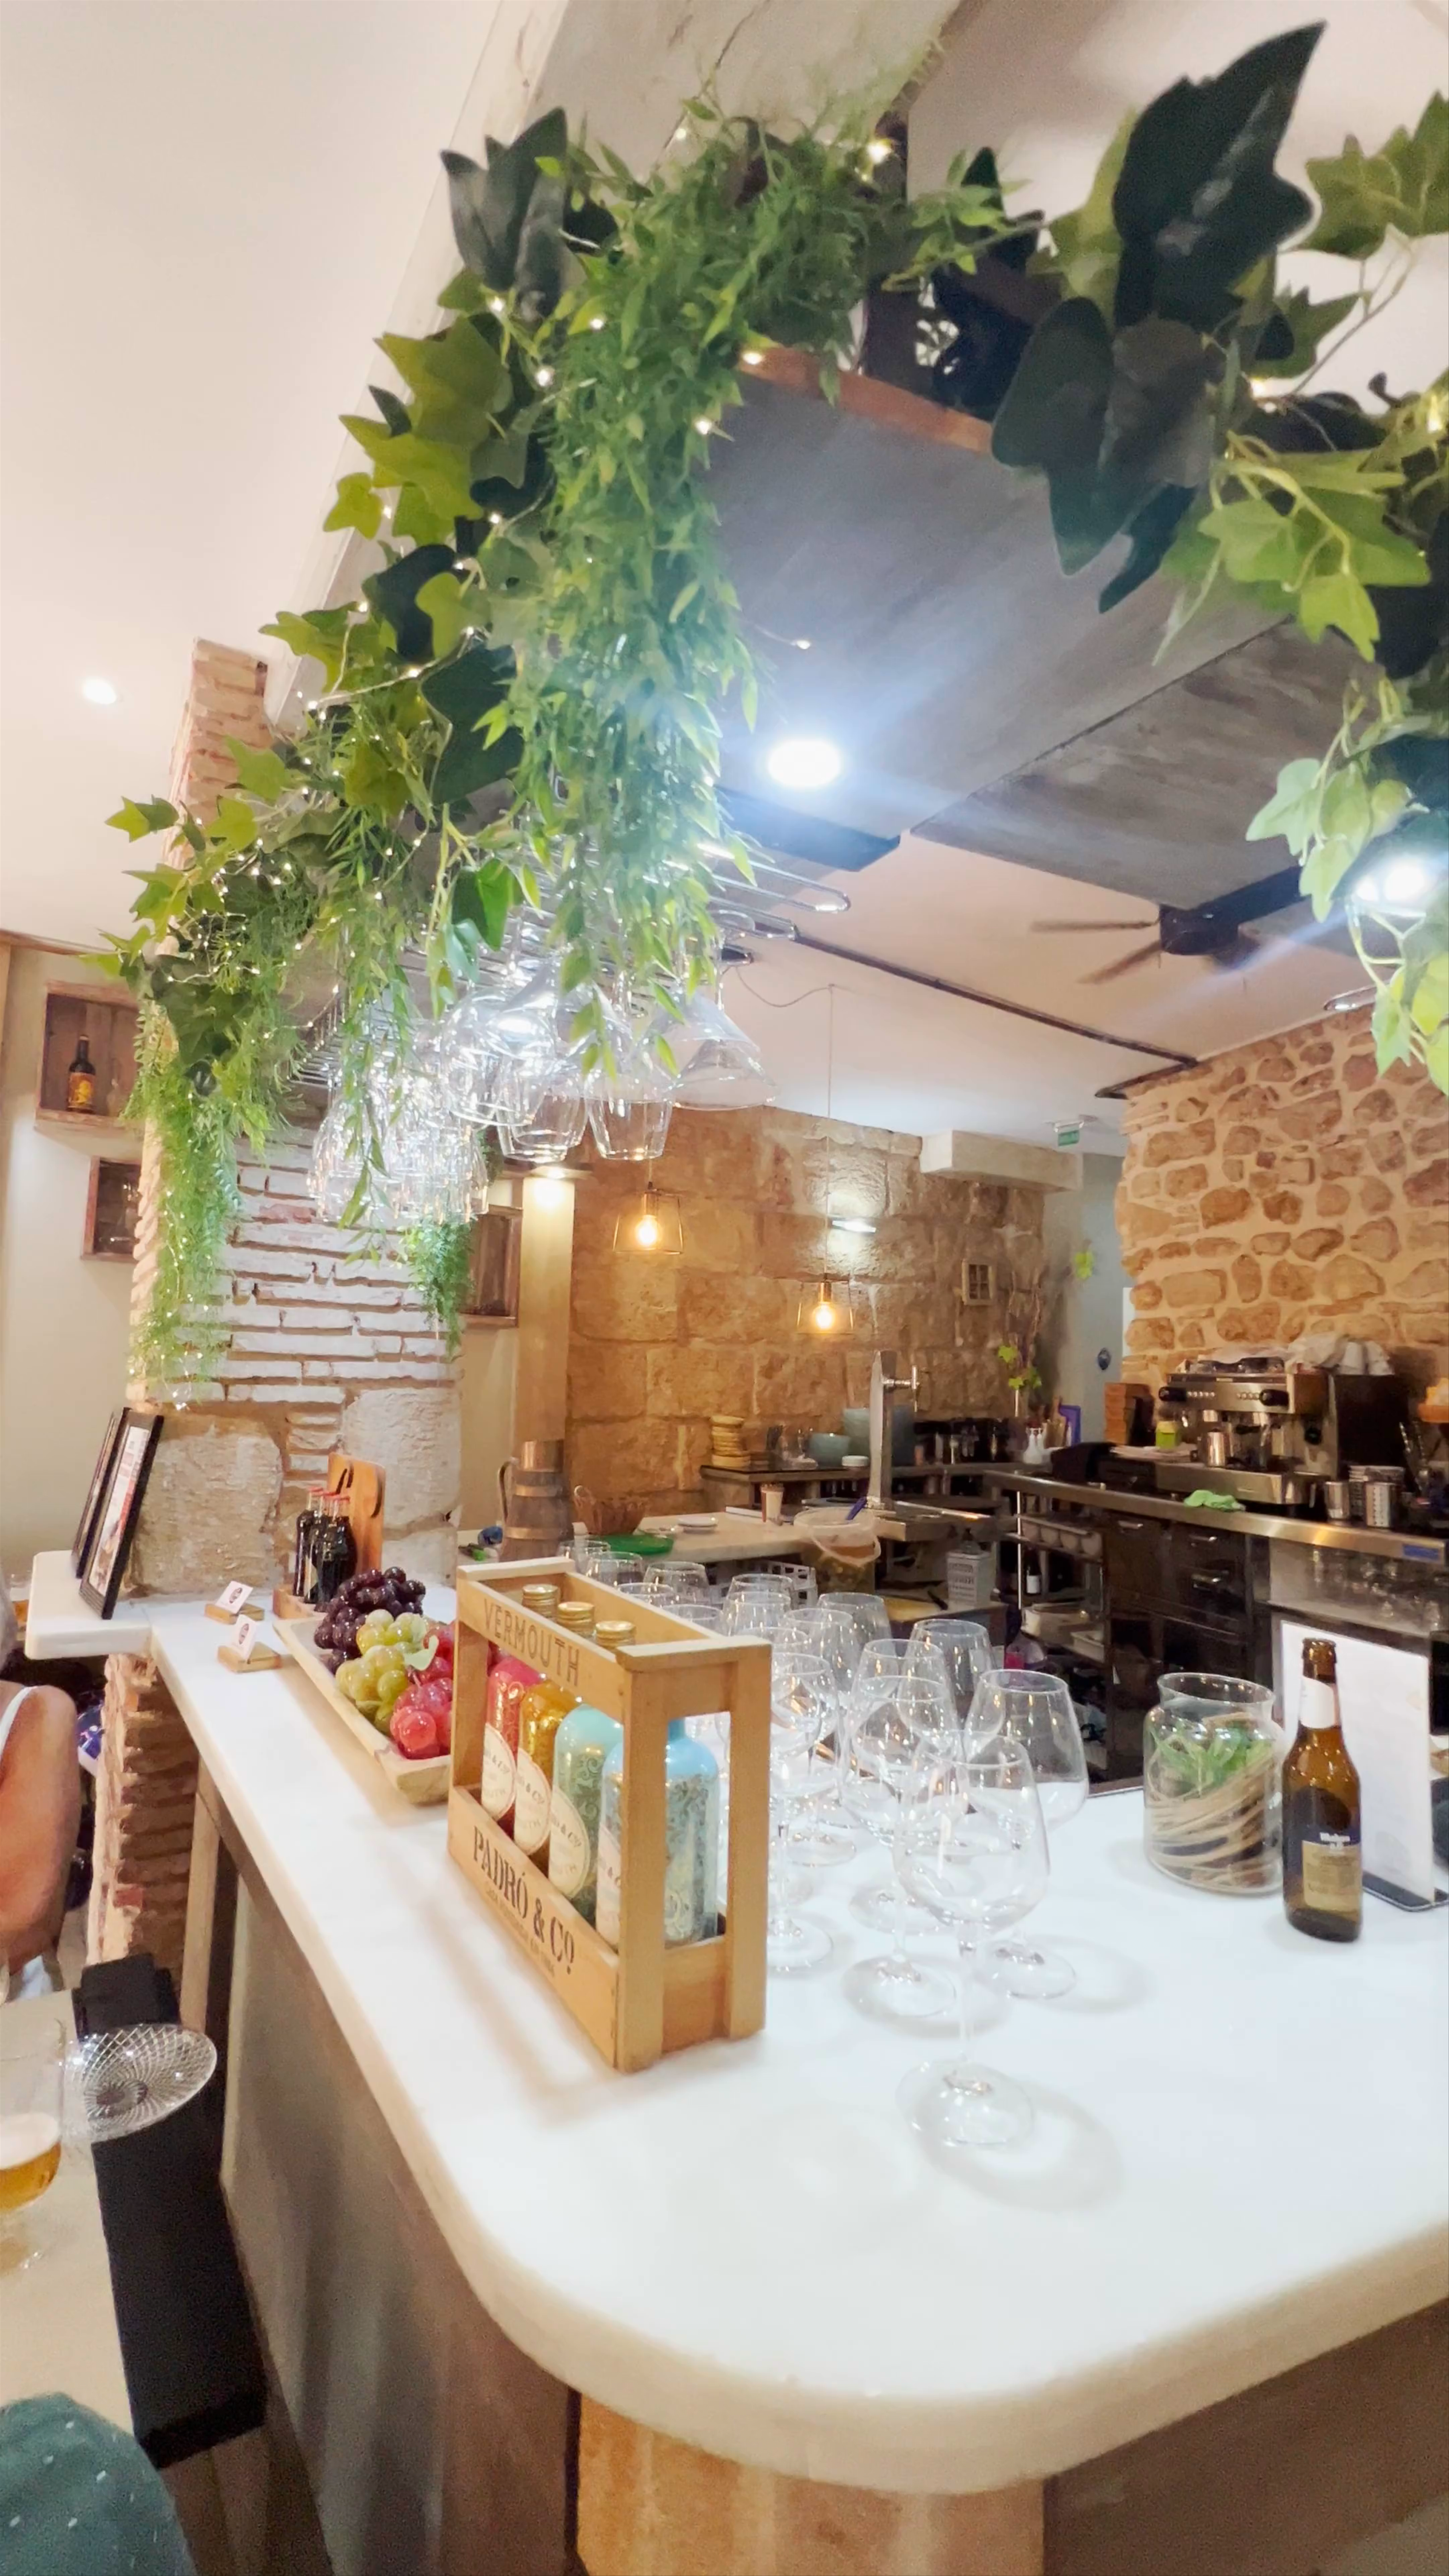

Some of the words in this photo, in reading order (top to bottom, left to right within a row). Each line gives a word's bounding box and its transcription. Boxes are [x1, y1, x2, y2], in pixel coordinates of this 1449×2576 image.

[484, 1598, 580, 1687] VERMOUTH
[474, 1825, 528, 1919] PADRÓ
[533, 1897, 545, 1943] &
